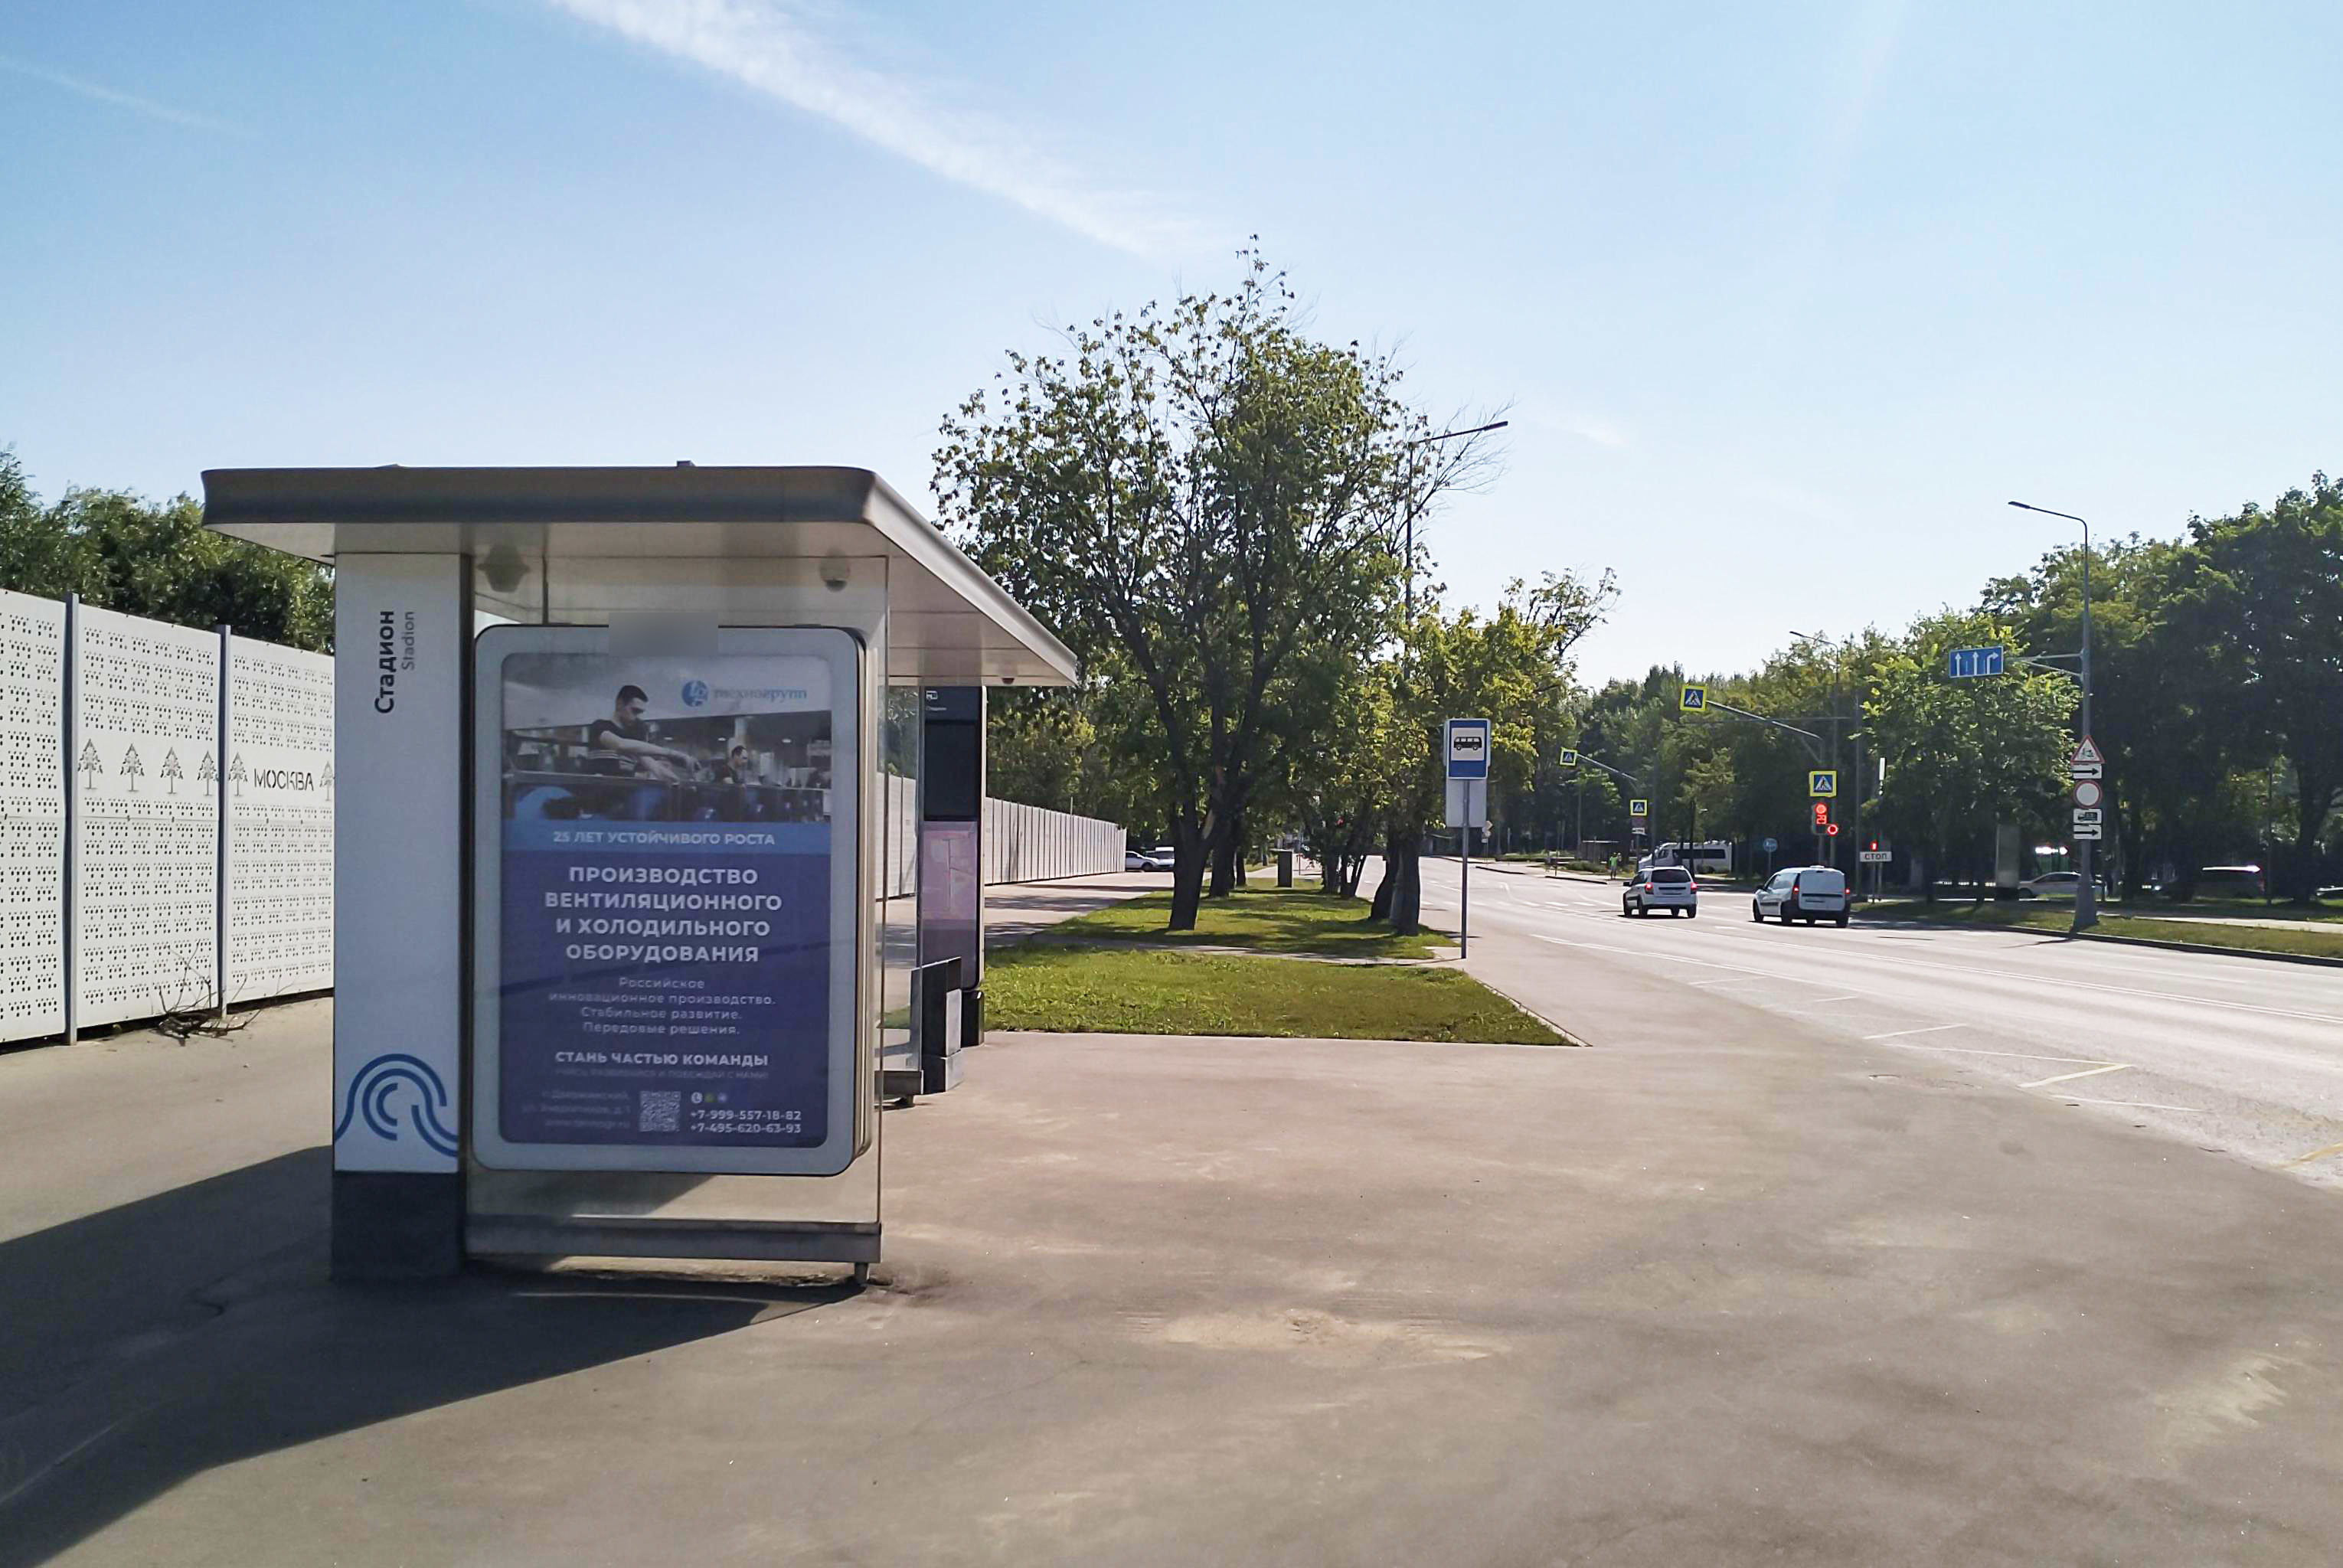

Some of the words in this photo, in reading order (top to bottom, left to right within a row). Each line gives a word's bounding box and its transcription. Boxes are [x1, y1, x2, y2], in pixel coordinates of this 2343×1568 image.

[401, 612, 415, 671] Stadion
[374, 611, 397, 714] Стадион
[253, 768, 314, 792] МОСКВА
[553, 831, 570, 842] 25
[573, 831, 603, 843] ЛЕТ
[606, 830, 721, 845] УСТОЙЧИВОГО
[724, 833, 775, 845] РОСТА
[569, 867, 758, 886] ПРОИЗВОДСТВО
[545, 892, 783, 911] ВЕНТИЛЯЦИОННОГО
[556, 918, 570, 933] И
[578, 919, 770, 937] ХОЛОДИЛЬНОГО
[566, 944, 759, 963] ОБОРУДОВАНИЯ
[619, 977, 705, 988] Российское
[549, 993, 665, 1004] инновационное
[668, 995, 776, 1005] производство.
[581, 1006, 666, 1018] Стабильное
[672, 1010, 742, 1020] развитие.
[583, 1022, 665, 1034] Передовые
[670, 1025, 740, 1035] решения.
[555, 1051, 607, 1063] СТАНЬ
[611, 1052, 678, 1065] ЧАСТЬЮ
[682, 1054, 768, 1067] КОМАНДЫ
[691, 1110, 802, 1120] +7-999-557-18-82
[691, 1122, 802, 1133] +7-495-620-63-93
